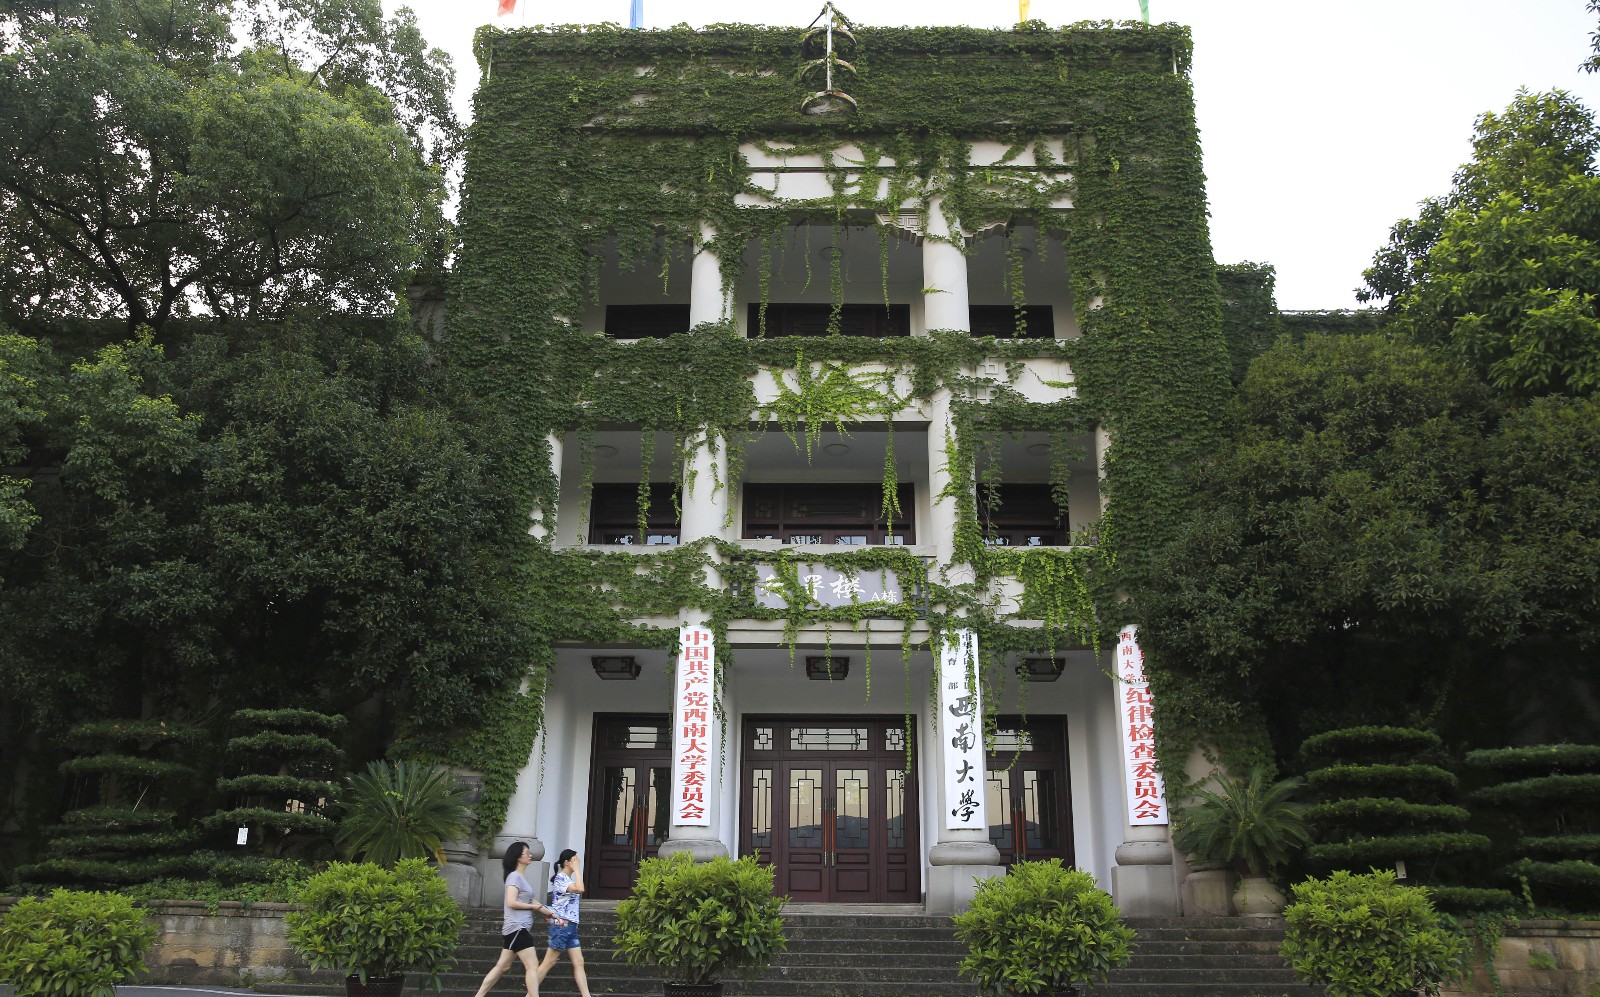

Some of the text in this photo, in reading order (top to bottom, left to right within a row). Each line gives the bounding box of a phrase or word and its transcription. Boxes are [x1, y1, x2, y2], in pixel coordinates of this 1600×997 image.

[870, 590, 898, 603] A栋
[1121, 632, 1136, 684] 西南大学
[679, 630, 709, 820] 中国共产党西南大学委员会
[1126, 686, 1162, 819] 纪律检查委员会
